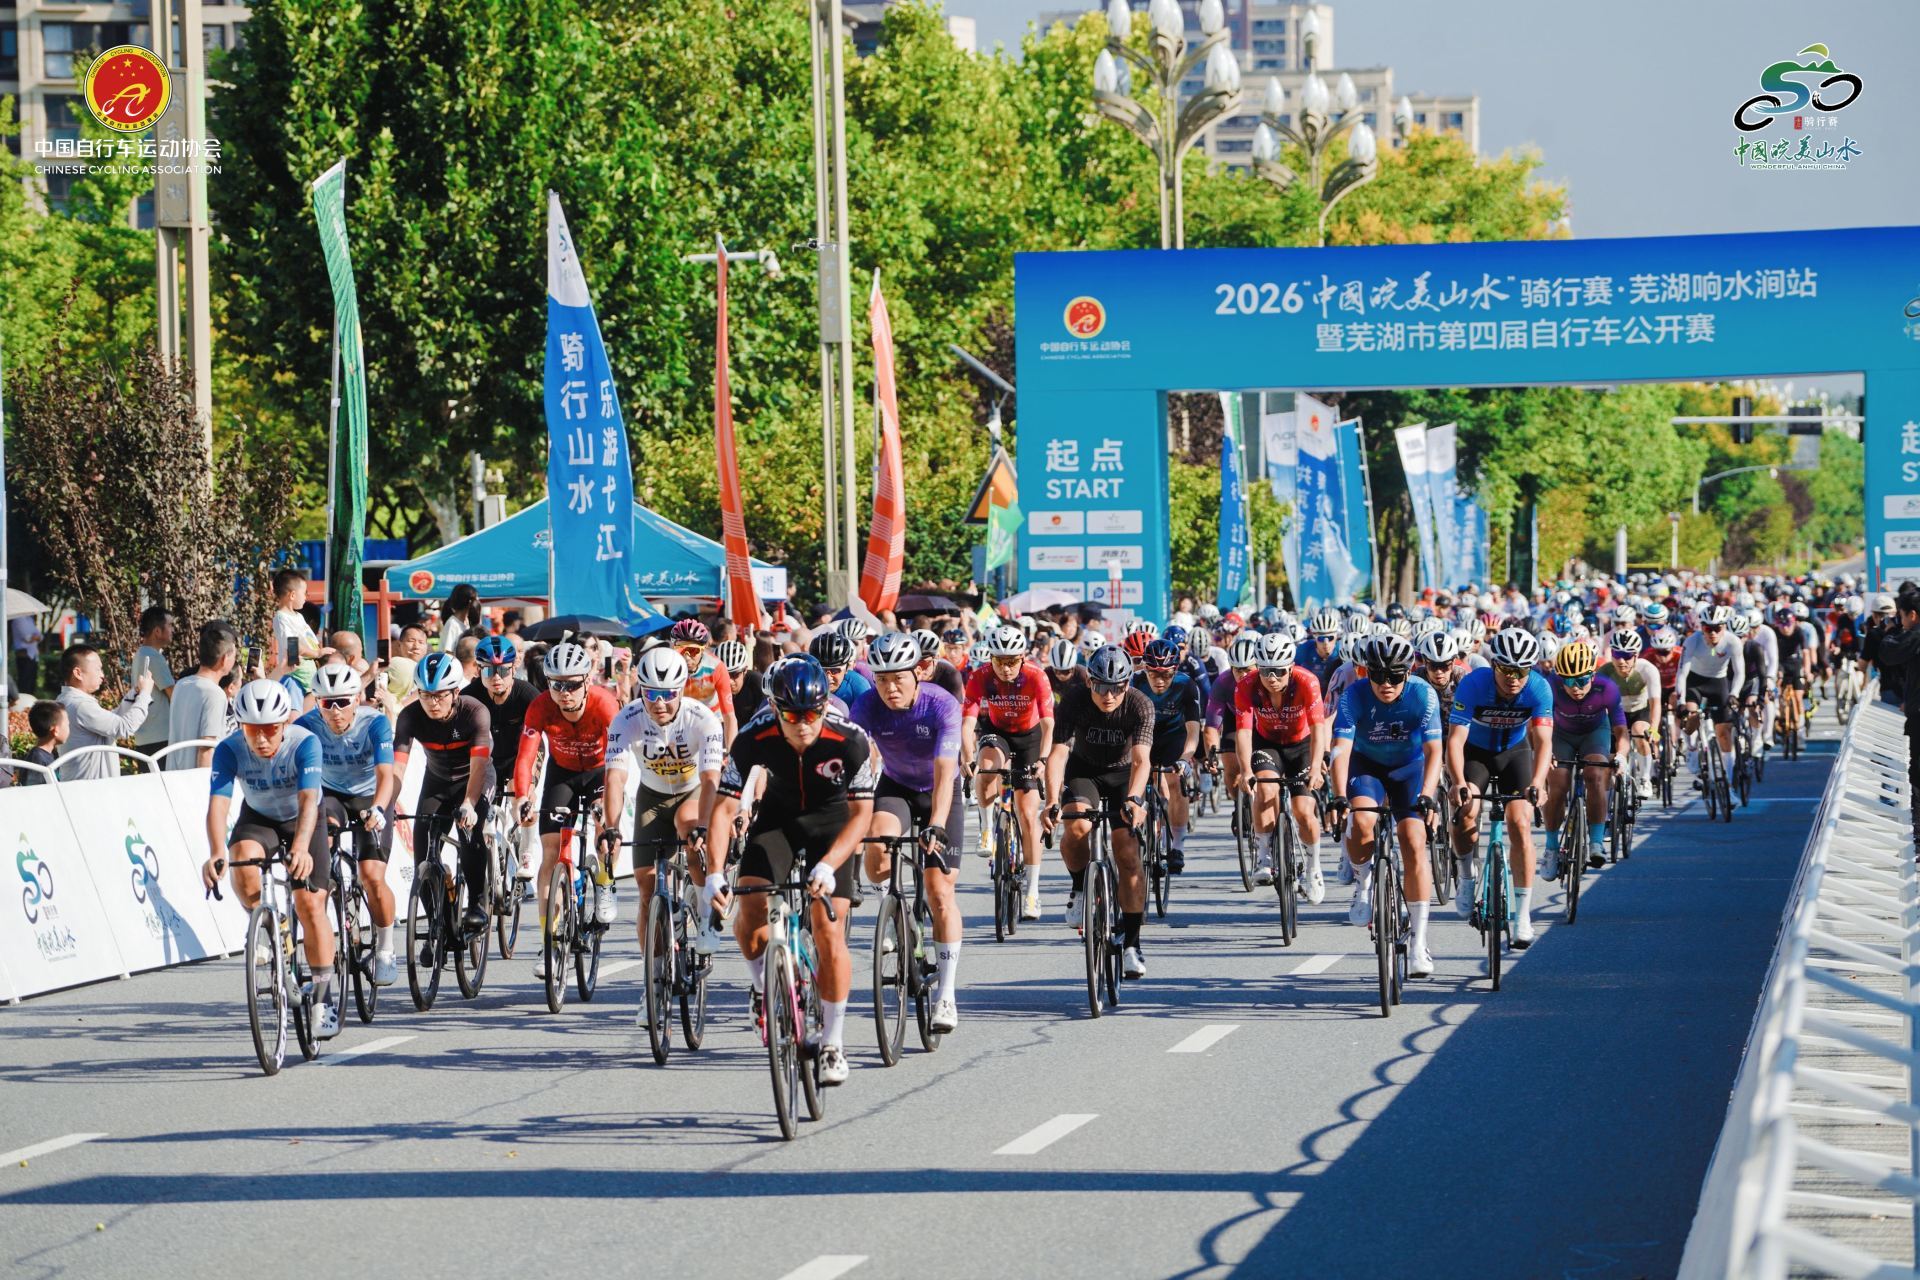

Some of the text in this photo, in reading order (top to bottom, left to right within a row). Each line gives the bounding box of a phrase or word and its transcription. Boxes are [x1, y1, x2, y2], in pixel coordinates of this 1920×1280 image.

[1316, 313, 1716, 353] 暨芜湖市第四届自行车公开赛
[560, 333, 594, 515] 骑行山水
[596, 380, 624, 562] 乐游弋江
[1045, 438, 1124, 473] 起点
[1046, 478, 1125, 500] START
[643, 744, 691, 760] UAE
